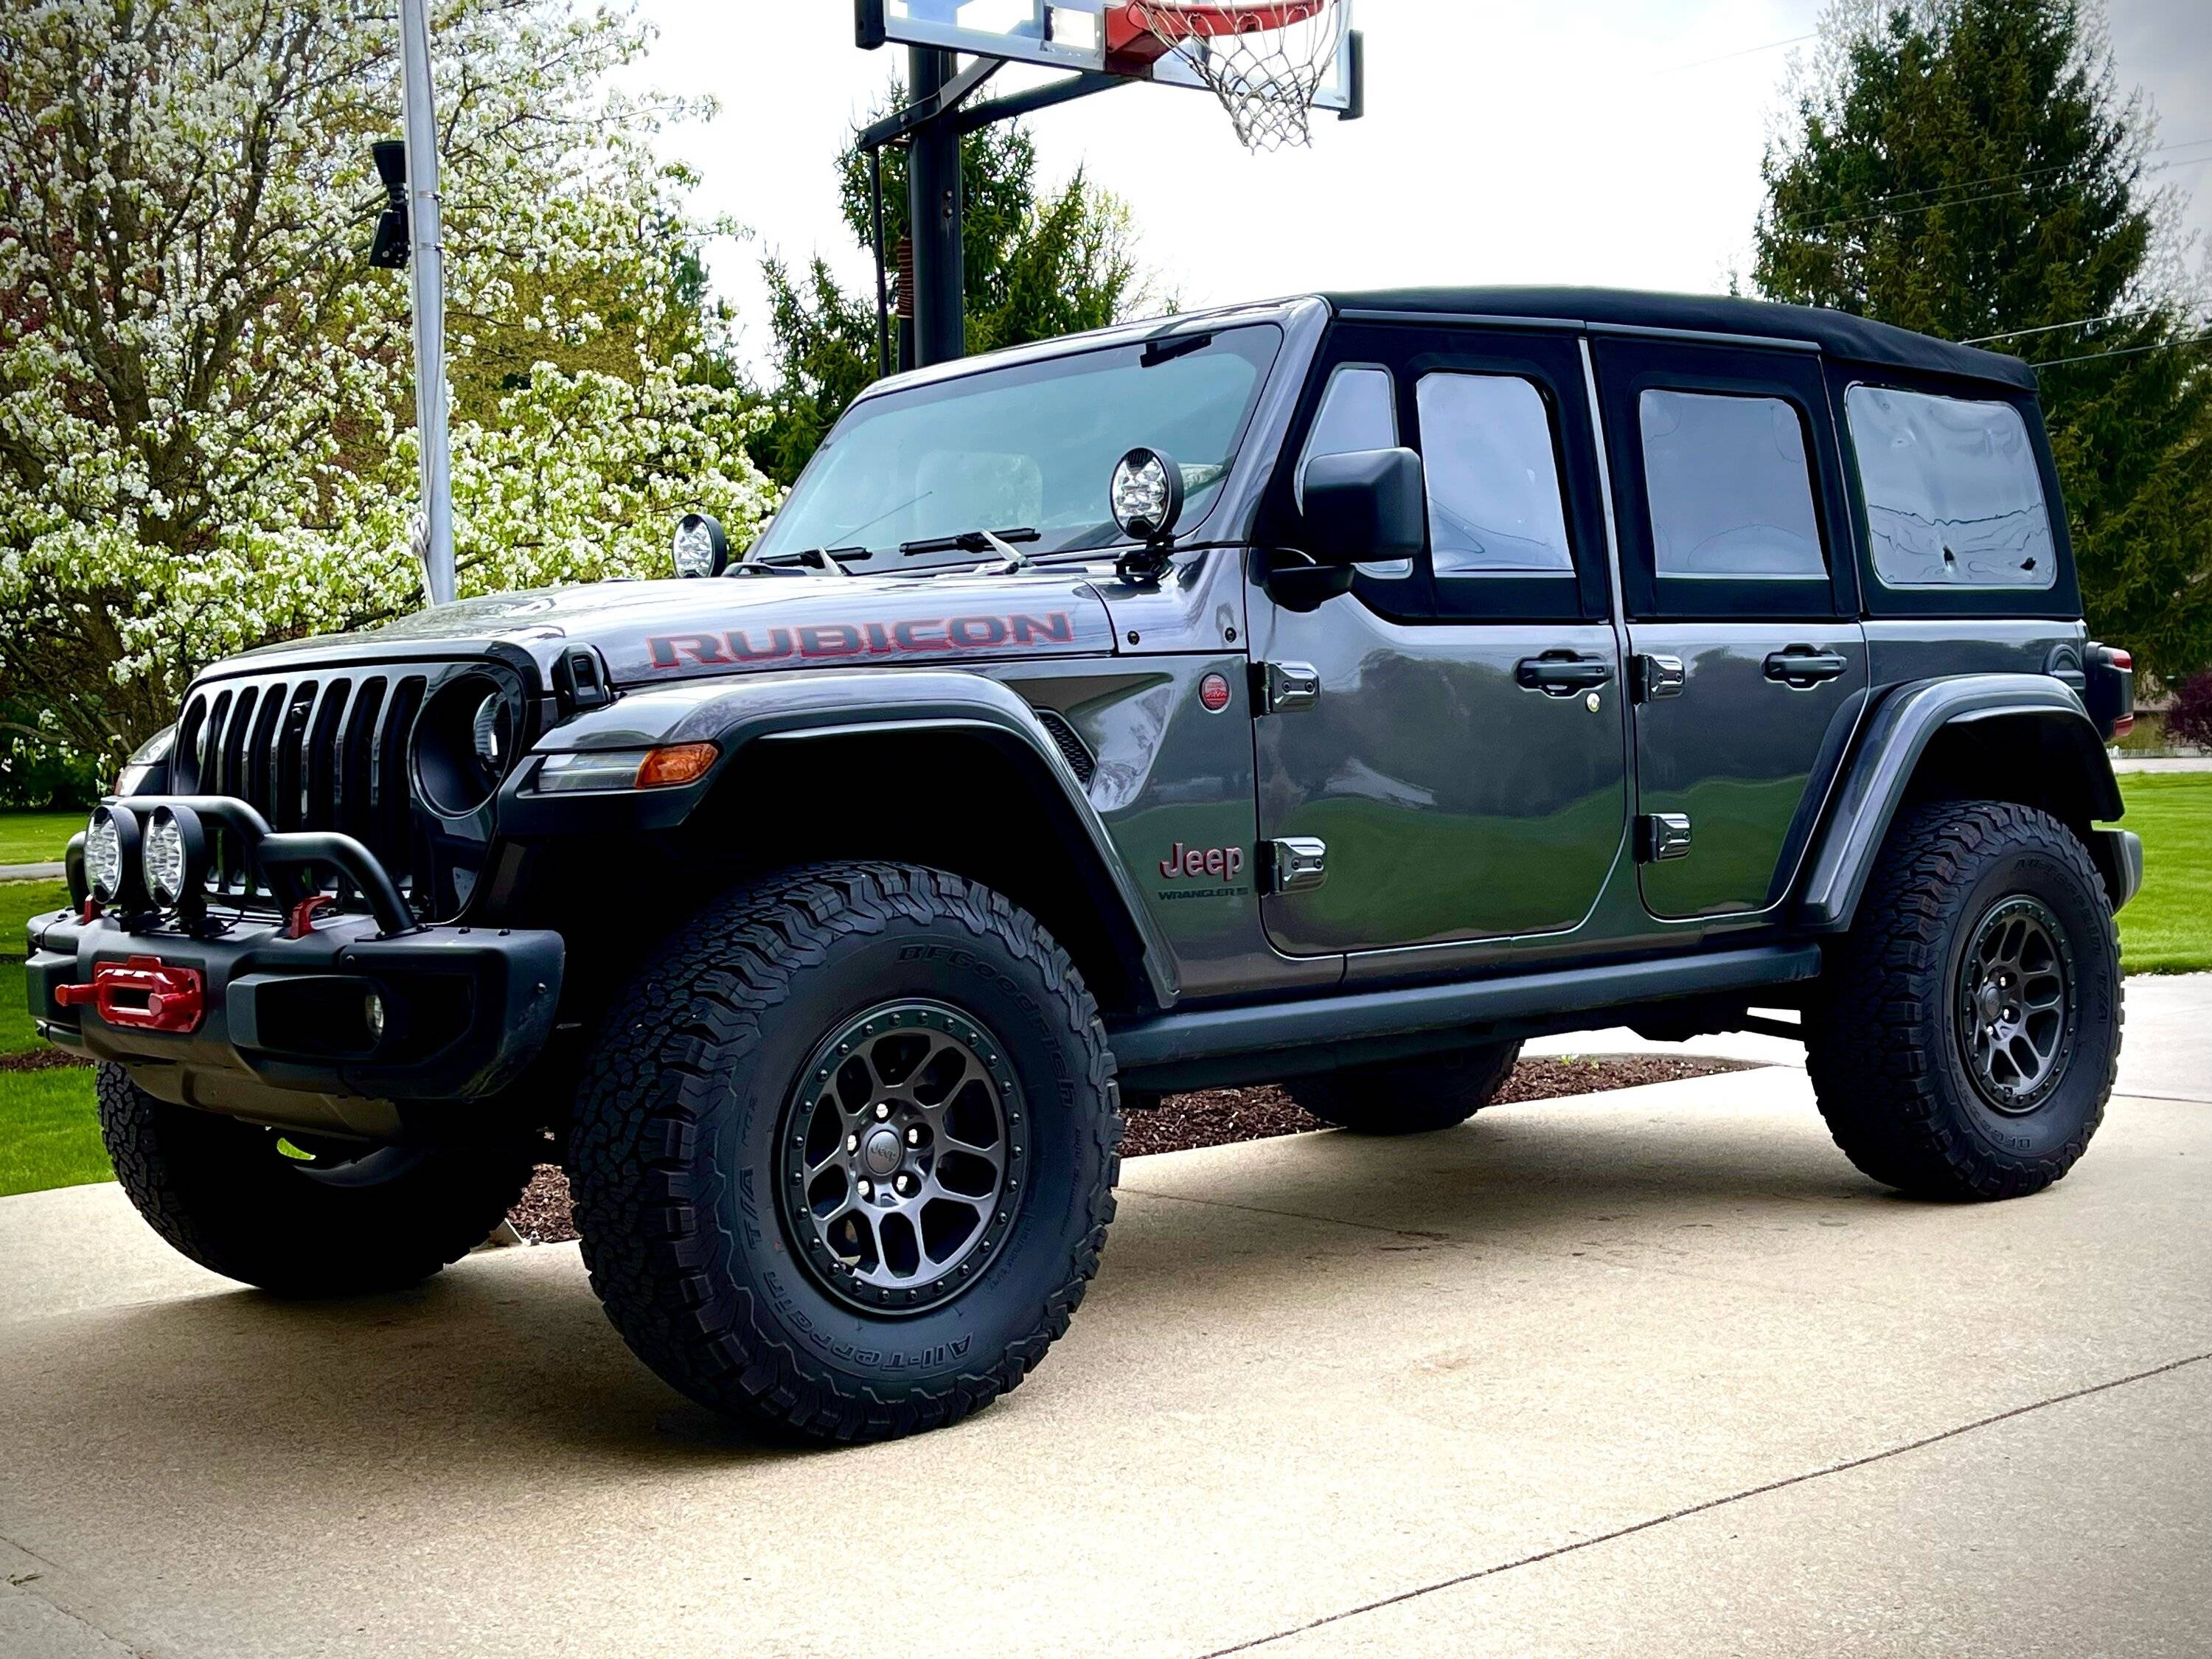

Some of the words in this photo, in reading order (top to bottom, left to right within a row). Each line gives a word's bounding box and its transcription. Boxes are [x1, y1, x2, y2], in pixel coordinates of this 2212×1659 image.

[645, 612, 1074, 669] RUBICON
[1160, 842, 1245, 882] Jeep
[1157, 887, 1237, 900] WRANGLER
